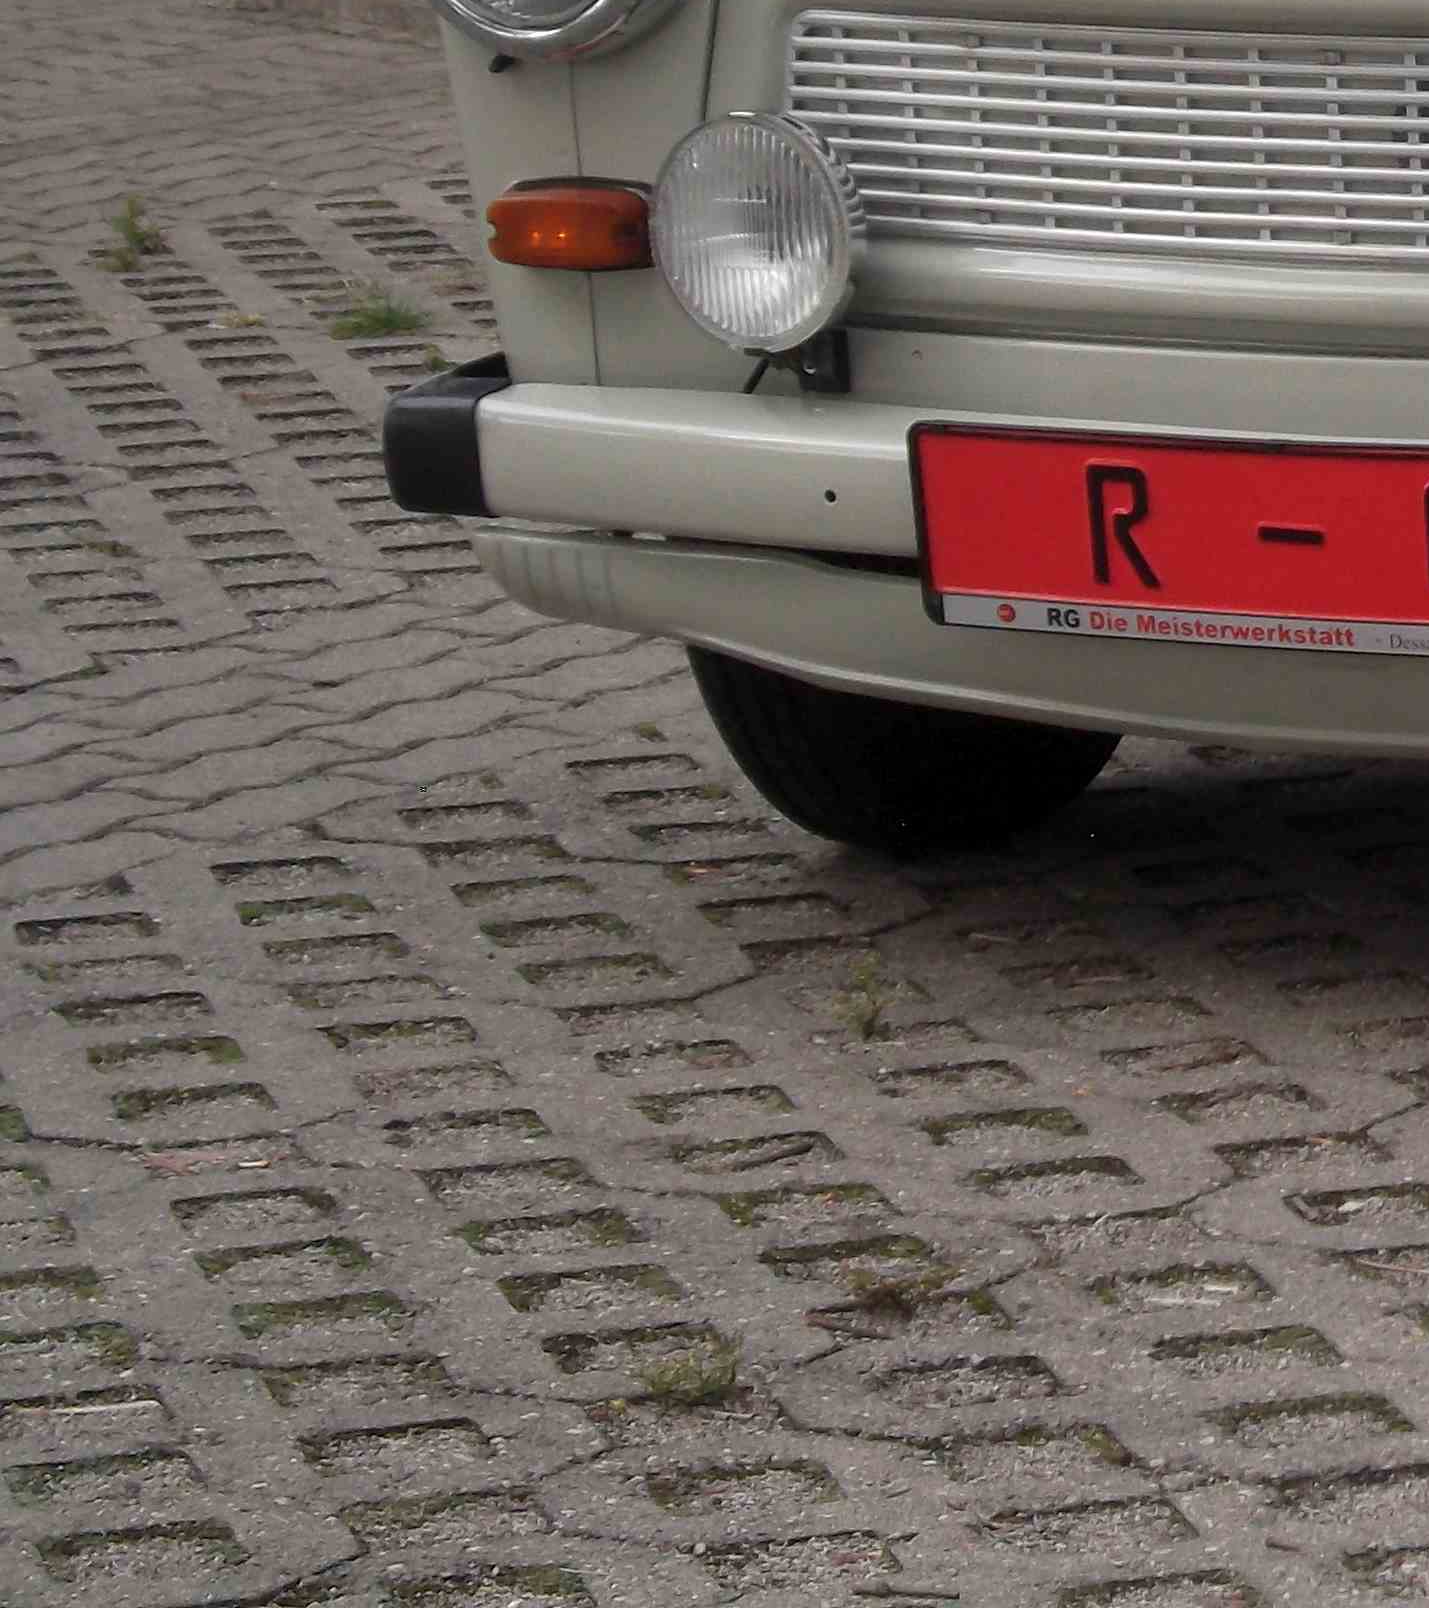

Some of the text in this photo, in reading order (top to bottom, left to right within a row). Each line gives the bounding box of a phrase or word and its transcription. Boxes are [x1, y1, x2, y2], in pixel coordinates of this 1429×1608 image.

[1086, 460, 1160, 587] R
[1047, 607, 1081, 629] RG
[1089, 609, 1129, 633] Die
[1136, 613, 1357, 647] Meisterwerkstatt
